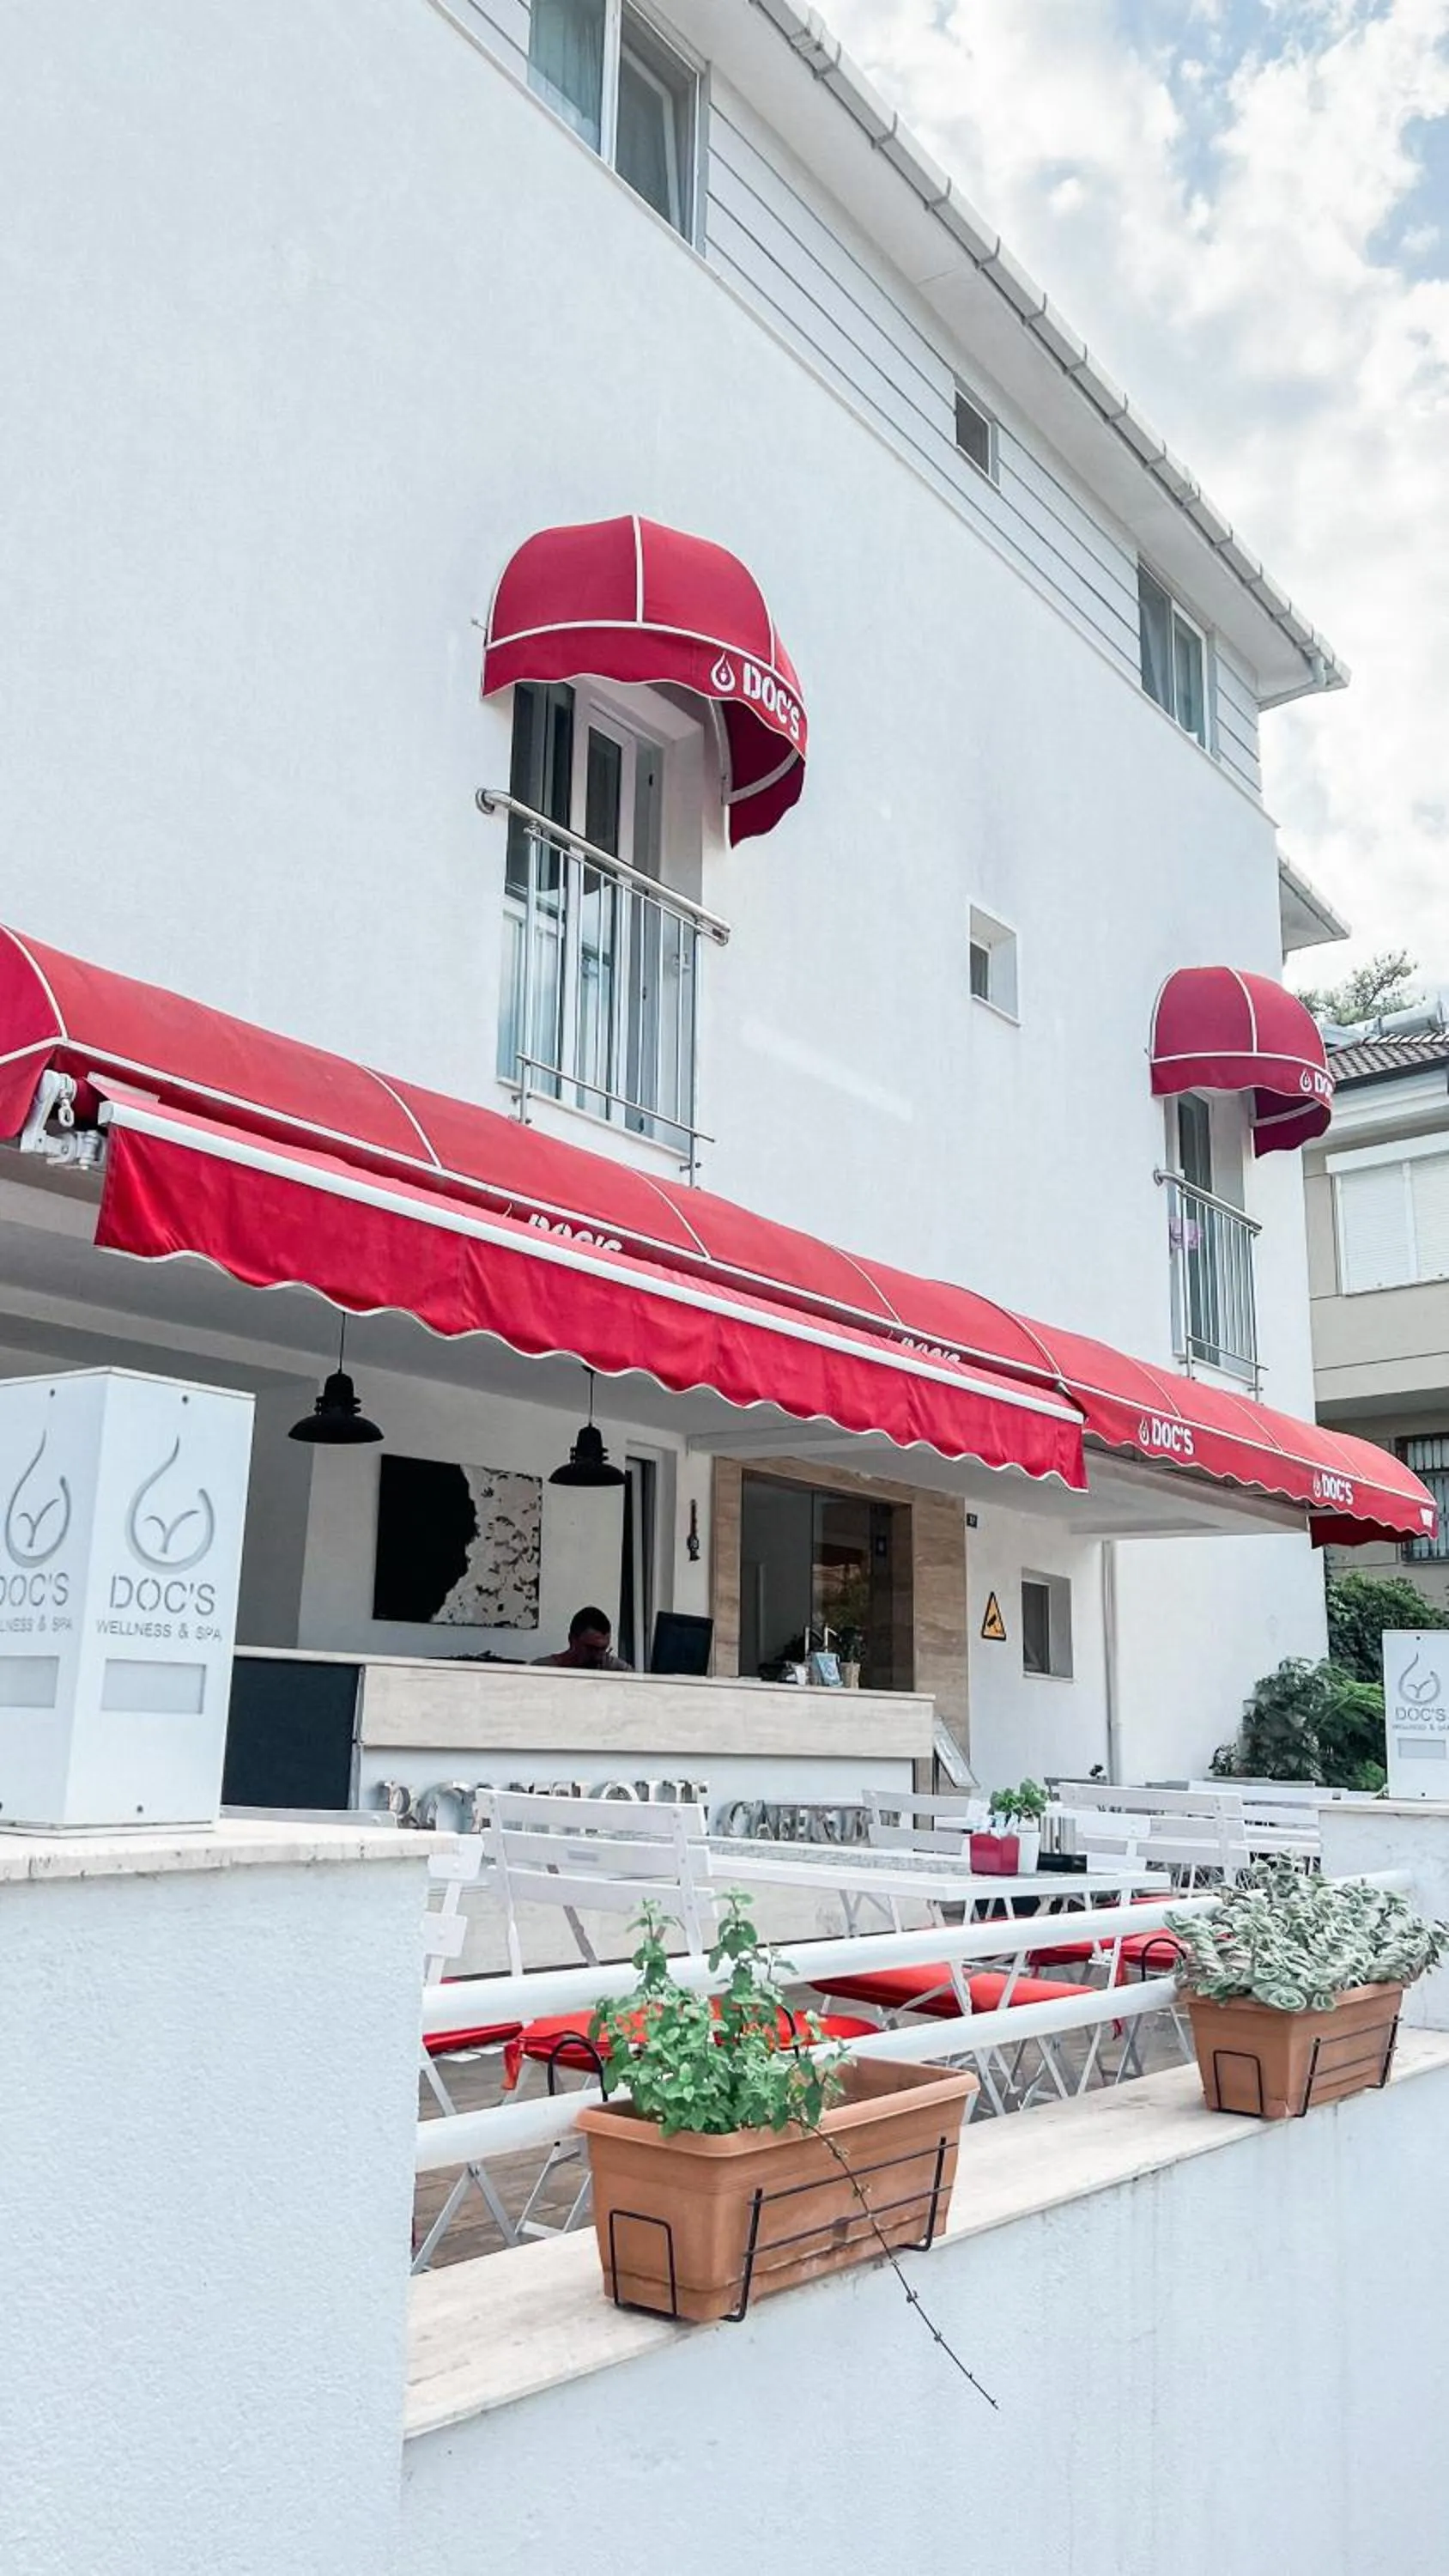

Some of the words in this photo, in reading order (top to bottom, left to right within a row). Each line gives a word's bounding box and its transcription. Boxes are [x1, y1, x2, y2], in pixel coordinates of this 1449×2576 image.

[743, 662, 800, 741] DOC'S
[1151, 1417, 1195, 1456] DOC'S
[1321, 1473, 1354, 1505] DOC'S
[109, 1575, 216, 1617] DOC'S
[96, 1619, 173, 1639] WELLNESS
[178, 1622, 189, 1640] &
[196, 1625, 223, 1642] SPA
[1395, 1706, 1446, 1722] DOC'S
